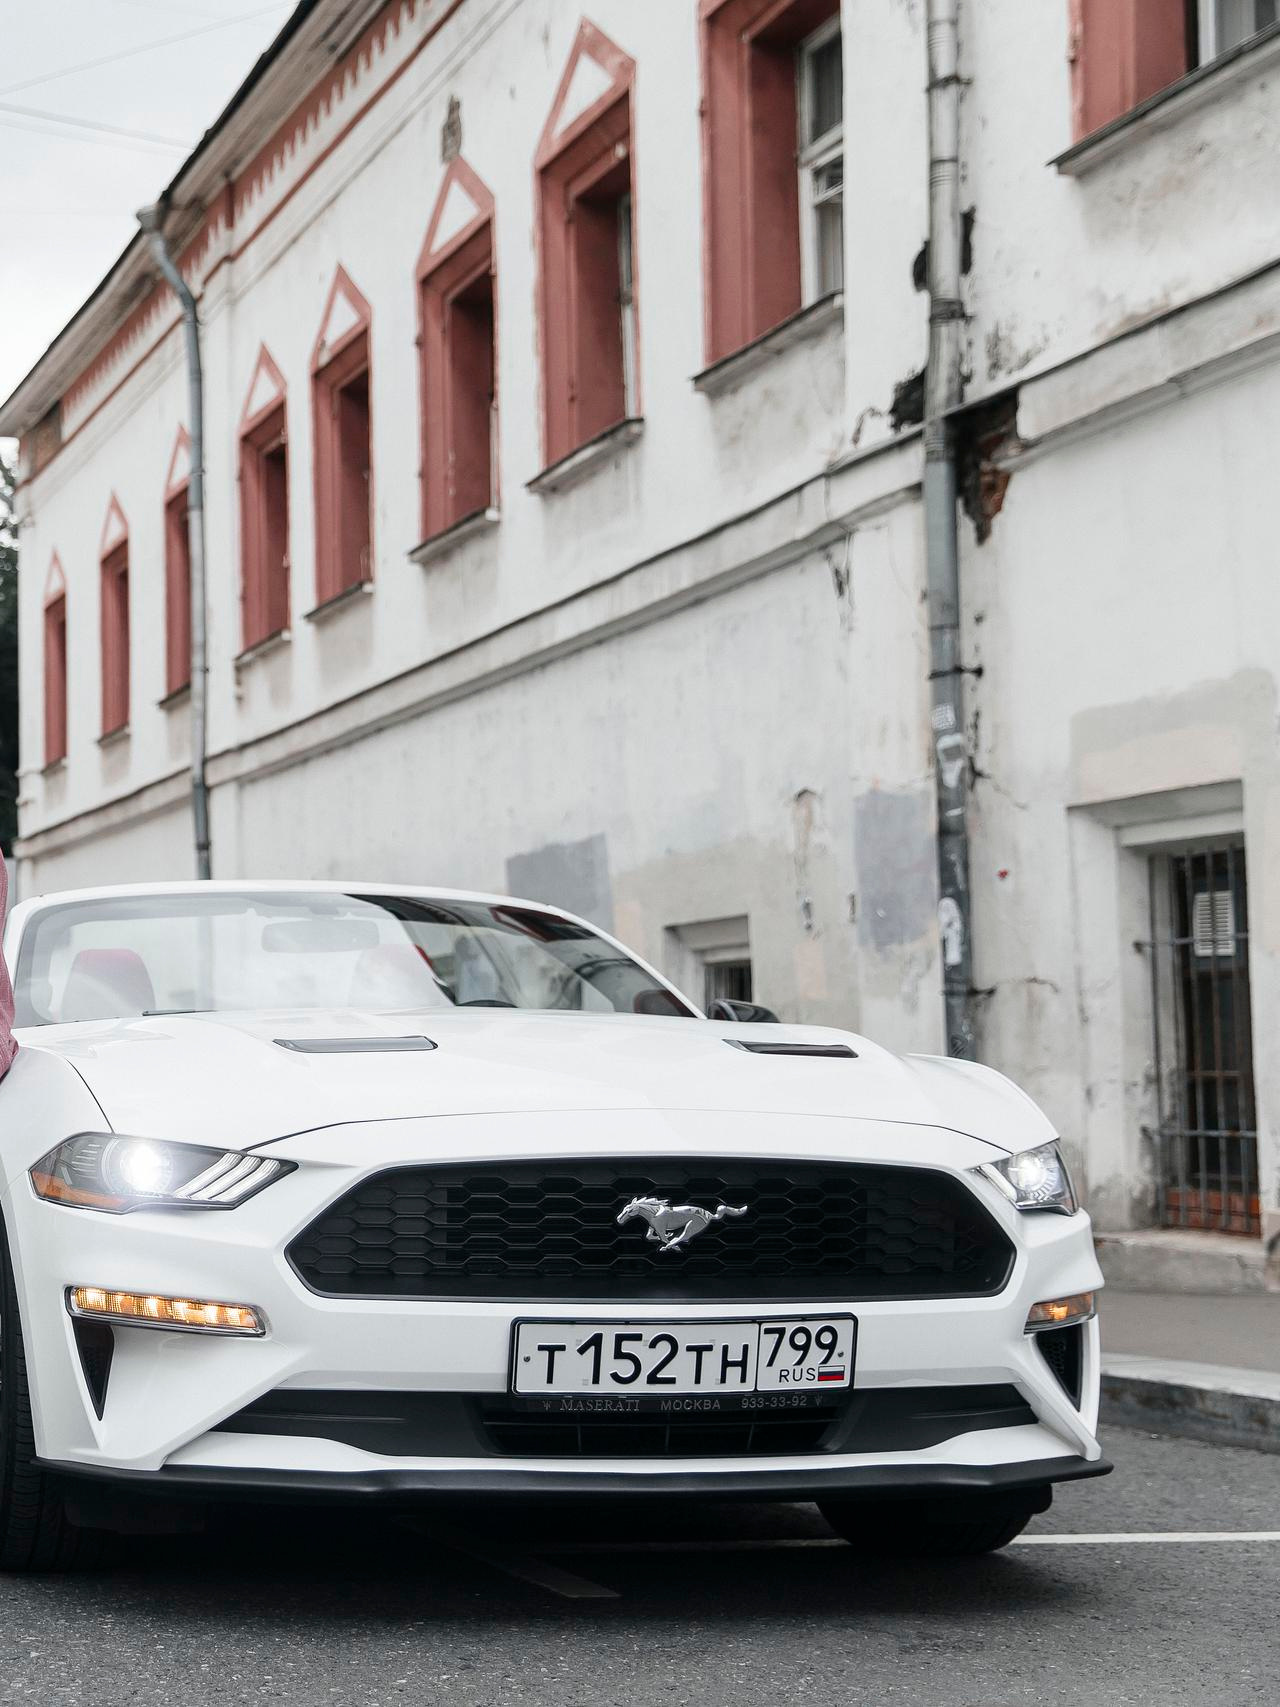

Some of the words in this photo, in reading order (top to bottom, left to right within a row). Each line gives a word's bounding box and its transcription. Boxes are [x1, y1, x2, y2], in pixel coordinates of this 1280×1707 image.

[763, 1325, 839, 1368] 799
[778, 1368, 816, 1383] RUS
[559, 1399, 640, 1411] MASERATI
[660, 1398, 721, 1411] МОСКВА
[741, 1396, 807, 1409] 933-33-92
